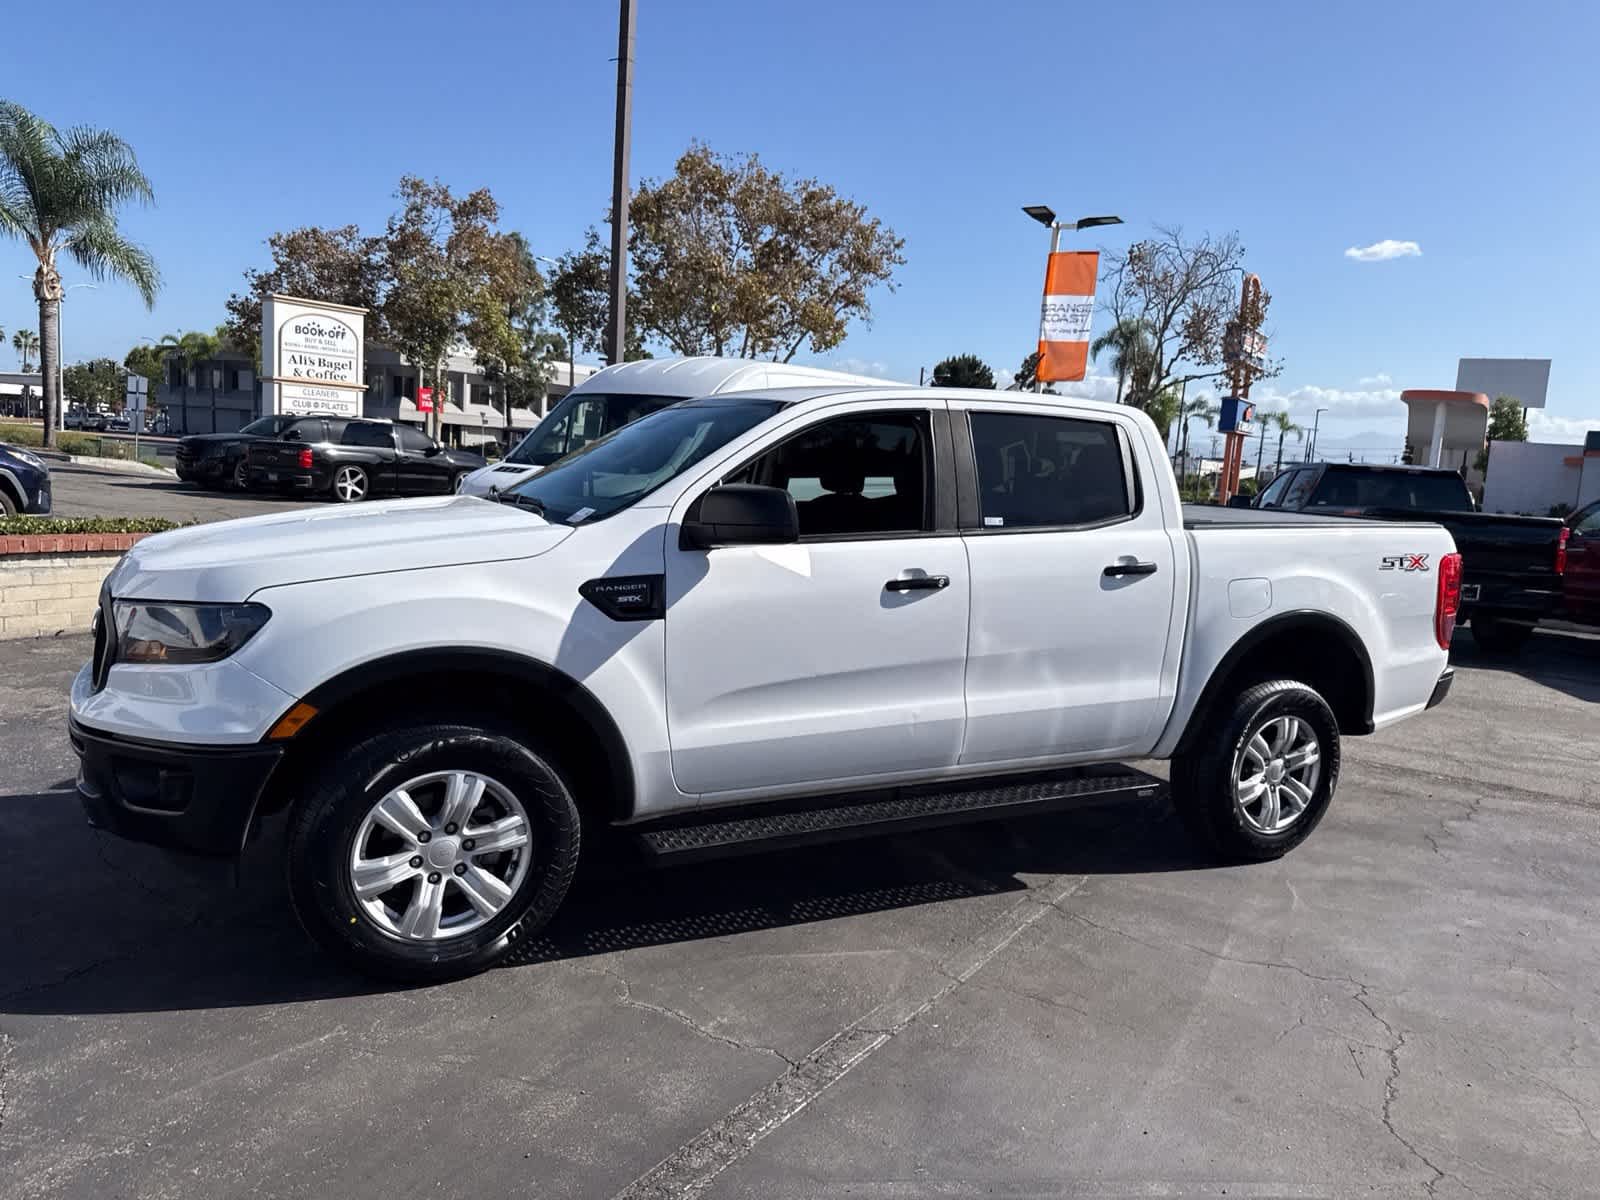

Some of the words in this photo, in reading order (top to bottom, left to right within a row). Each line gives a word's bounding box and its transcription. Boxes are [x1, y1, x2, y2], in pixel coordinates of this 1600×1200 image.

[318, 357, 352, 371] Bagel
[293, 367, 302, 377] &
[306, 368, 347, 381] Coffee
[302, 388, 339, 398] CLEANERS
[292, 400, 311, 408] CLUB
[321, 402, 348, 411] PILATES
[1379, 553, 1430, 571] STX
[595, 583, 647, 592] RANGER
